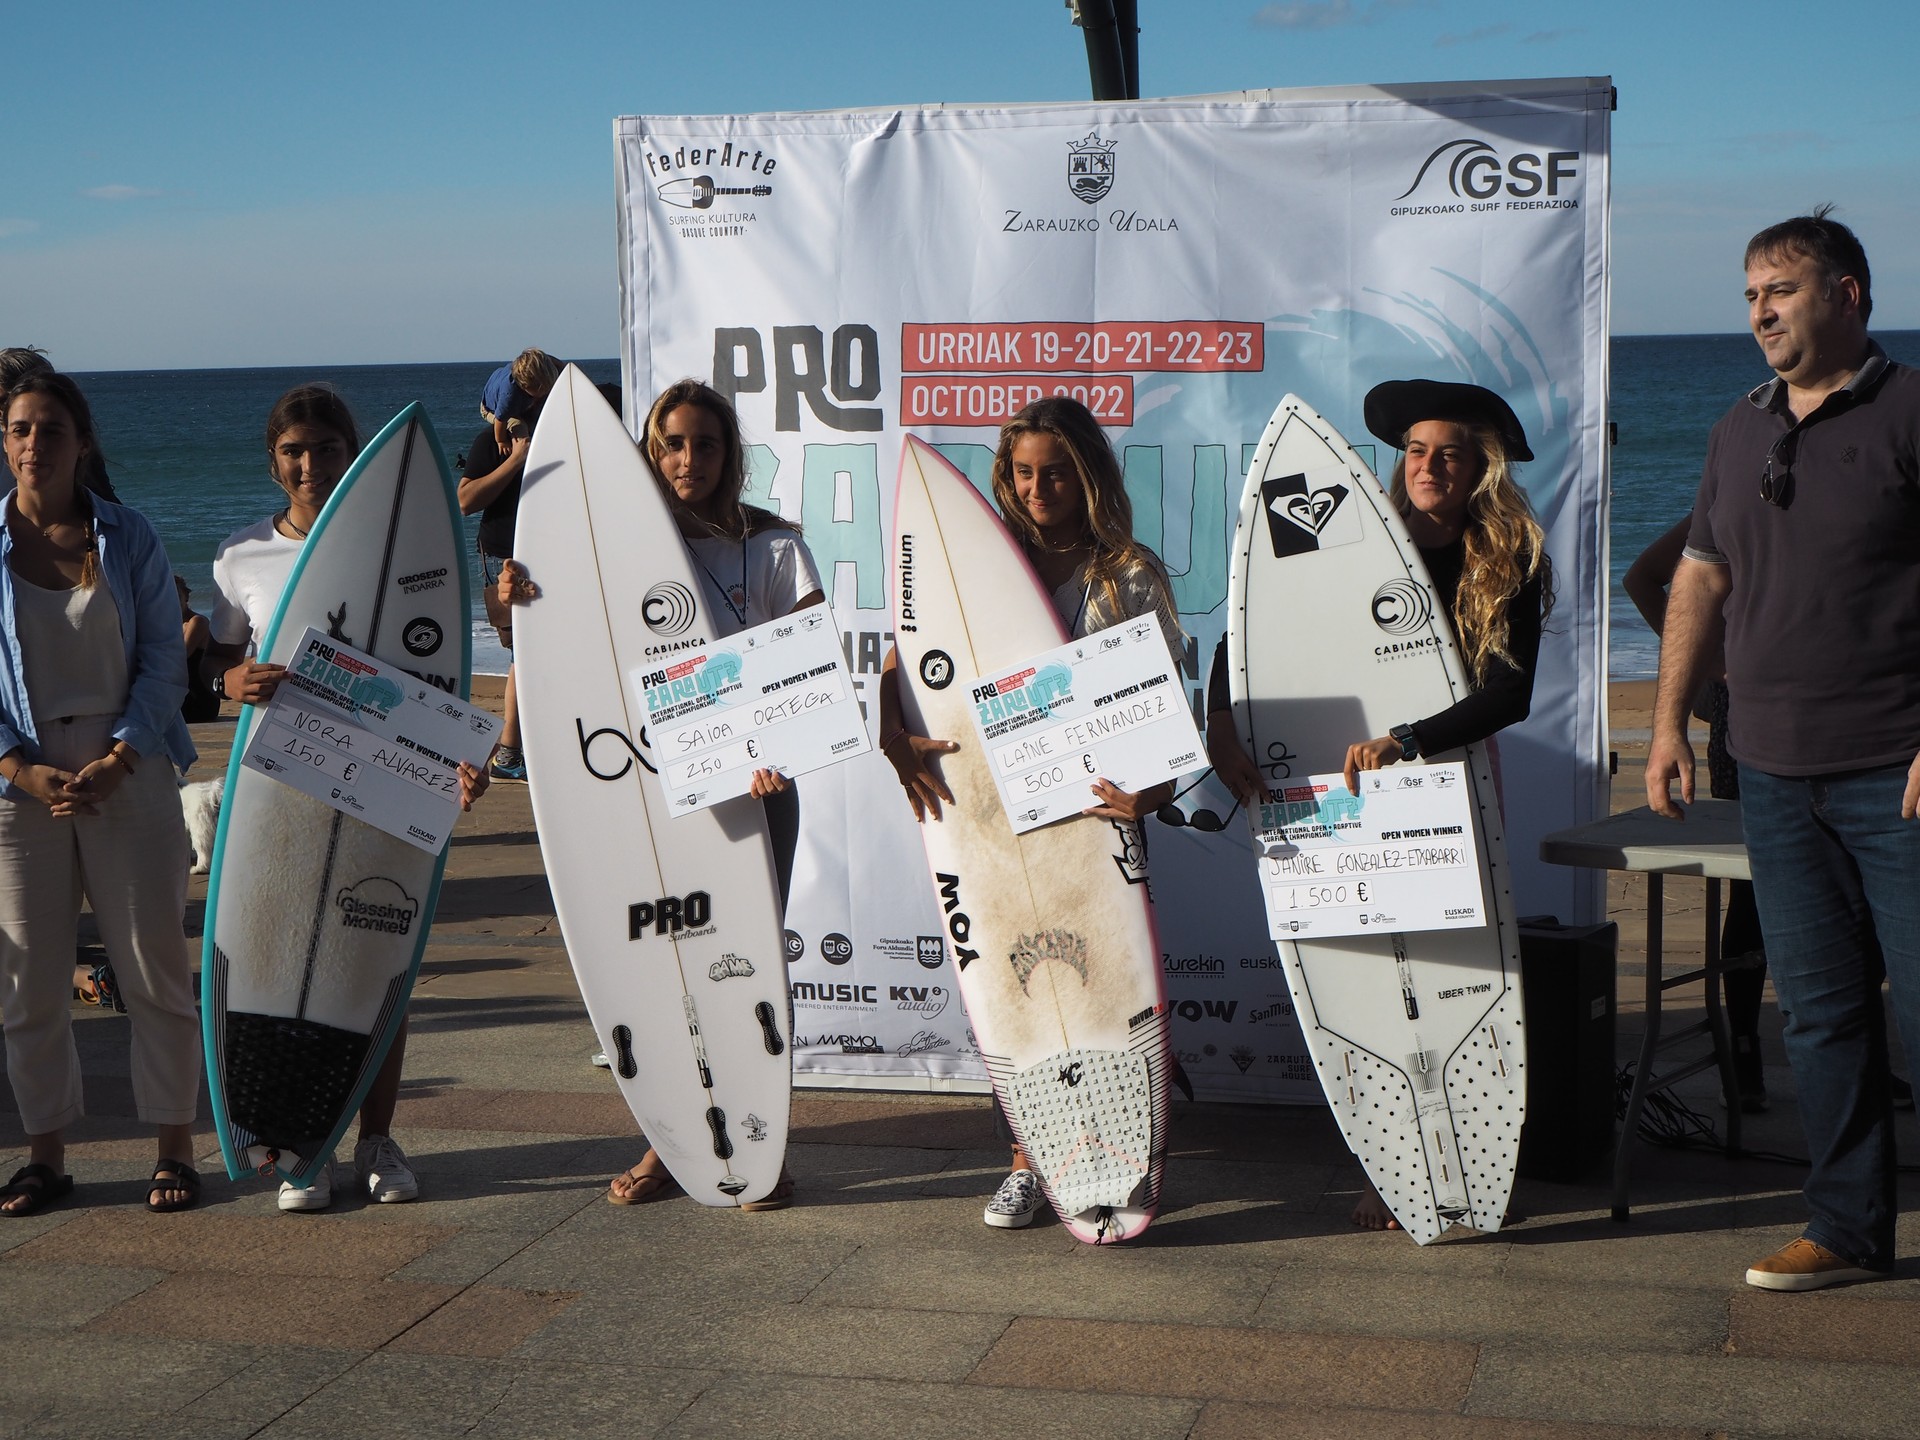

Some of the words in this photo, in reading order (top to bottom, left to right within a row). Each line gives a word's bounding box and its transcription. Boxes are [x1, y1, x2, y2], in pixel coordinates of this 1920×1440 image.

[645, 143, 777, 177] FederArte
[1461, 151, 1580, 199] GSF
[1390, 204, 1465, 216] GIPUZKOAKO
[1470, 202, 1501, 212] SURF
[1506, 199, 1579, 210] FEDERAZIOA
[669, 214, 705, 226] SURFING
[708, 212, 757, 223] KULTURA
[917, 331, 1022, 364] URRIAK
[1031, 331, 1253, 365] 19-20-21-22-23
[712, 322, 884, 432] PRO
[397, 568, 448, 586] GROSEKO
[403, 578, 445, 595] INDARRA
[899, 534, 916, 620] premium
[777, 625, 794, 638] GSF
[1105, 636, 1122, 649] GSF
[307, 639, 336, 663] PRO
[644, 637, 707, 656] CABIANCA
[1374, 636, 1443, 656] CABIANCA
[296, 652, 397, 714] ZARAUTZ
[641, 669, 668, 690] PRO
[644, 660, 741, 712] ZARAUTZ
[761, 682, 781, 694] OPEN
[781, 672, 808, 687] WOMEN
[808, 661, 838, 678] WINNER
[650, 700, 695, 720] INTERNATIONAL
[695, 694, 711, 704] OPEN
[715, 682, 743, 697] ADAPTIVE
[972, 682, 998, 704] PRO
[975, 672, 1072, 726] ZARAUTZ
[1093, 694, 1113, 708] OPEN
[1113, 684, 1140, 701] WOMEN
[1139, 673, 1169, 691] WINNER
[445, 706, 464, 719] GSF
[651, 713, 676, 726] SURFING
[676, 698, 717, 718] CHAMPIONSHIP
[753, 691, 834, 726] ORTEGA
[983, 713, 1028, 734] INTERNATIONAL
[1027, 706, 1043, 717] OPEN
[1047, 694, 1075, 710] ADAPTIVE
[985, 727, 1009, 741] SURFING
[1009, 711, 1050, 732] CHAMPIONSHIP
[1063, 696, 1167, 746] FERNANDEZ
[293, 711, 354, 749] NORA
[371, 748, 459, 795] ALVAREZ
[395, 734, 416, 750] OPEN
[416, 743, 443, 762] WOMEN
[830, 736, 860, 752] EUSKADI
[284, 738, 326, 767] 150
[343, 762, 358, 782] €
[686, 757, 723, 779] 250
[746, 739, 759, 759] €
[1167, 751, 1197, 767] EUSKADI
[1024, 766, 1065, 795] 500
[1082, 753, 1096, 775] €
[1260, 798, 1361, 828] ZARAUTZ
[408, 825, 438, 842] EUSKADI
[1262, 827, 1310, 836] INTERNATIONAL
[1333, 822, 1362, 830] ADAPTIVE
[1289, 831, 1333, 841] CHAMPIONSHIP
[1381, 830, 1402, 840] OPEN
[1402, 827, 1431, 838] WOMEN
[1431, 825, 1463, 836] WINNER
[1356, 881, 1369, 903] €
[340, 896, 413, 924] Glassing
[628, 890, 711, 942] PRO
[1444, 907, 1475, 916] EUSKADI
[343, 914, 410, 935] Monkey
[668, 924, 718, 943] Surfboards
[1163, 954, 1225, 971] Zurekin
[1437, 986, 1465, 1000] UBER
[1466, 983, 1492, 996] TWIN
[822, 1004, 878, 1012] ENTERTAINMENT
[896, 996, 942, 1012] audio
[1249, 1002, 1294, 1024] SanMig
[1281, 1072, 1313, 1081] HOUSE
[1287, 1065, 1311, 1073] SURF
